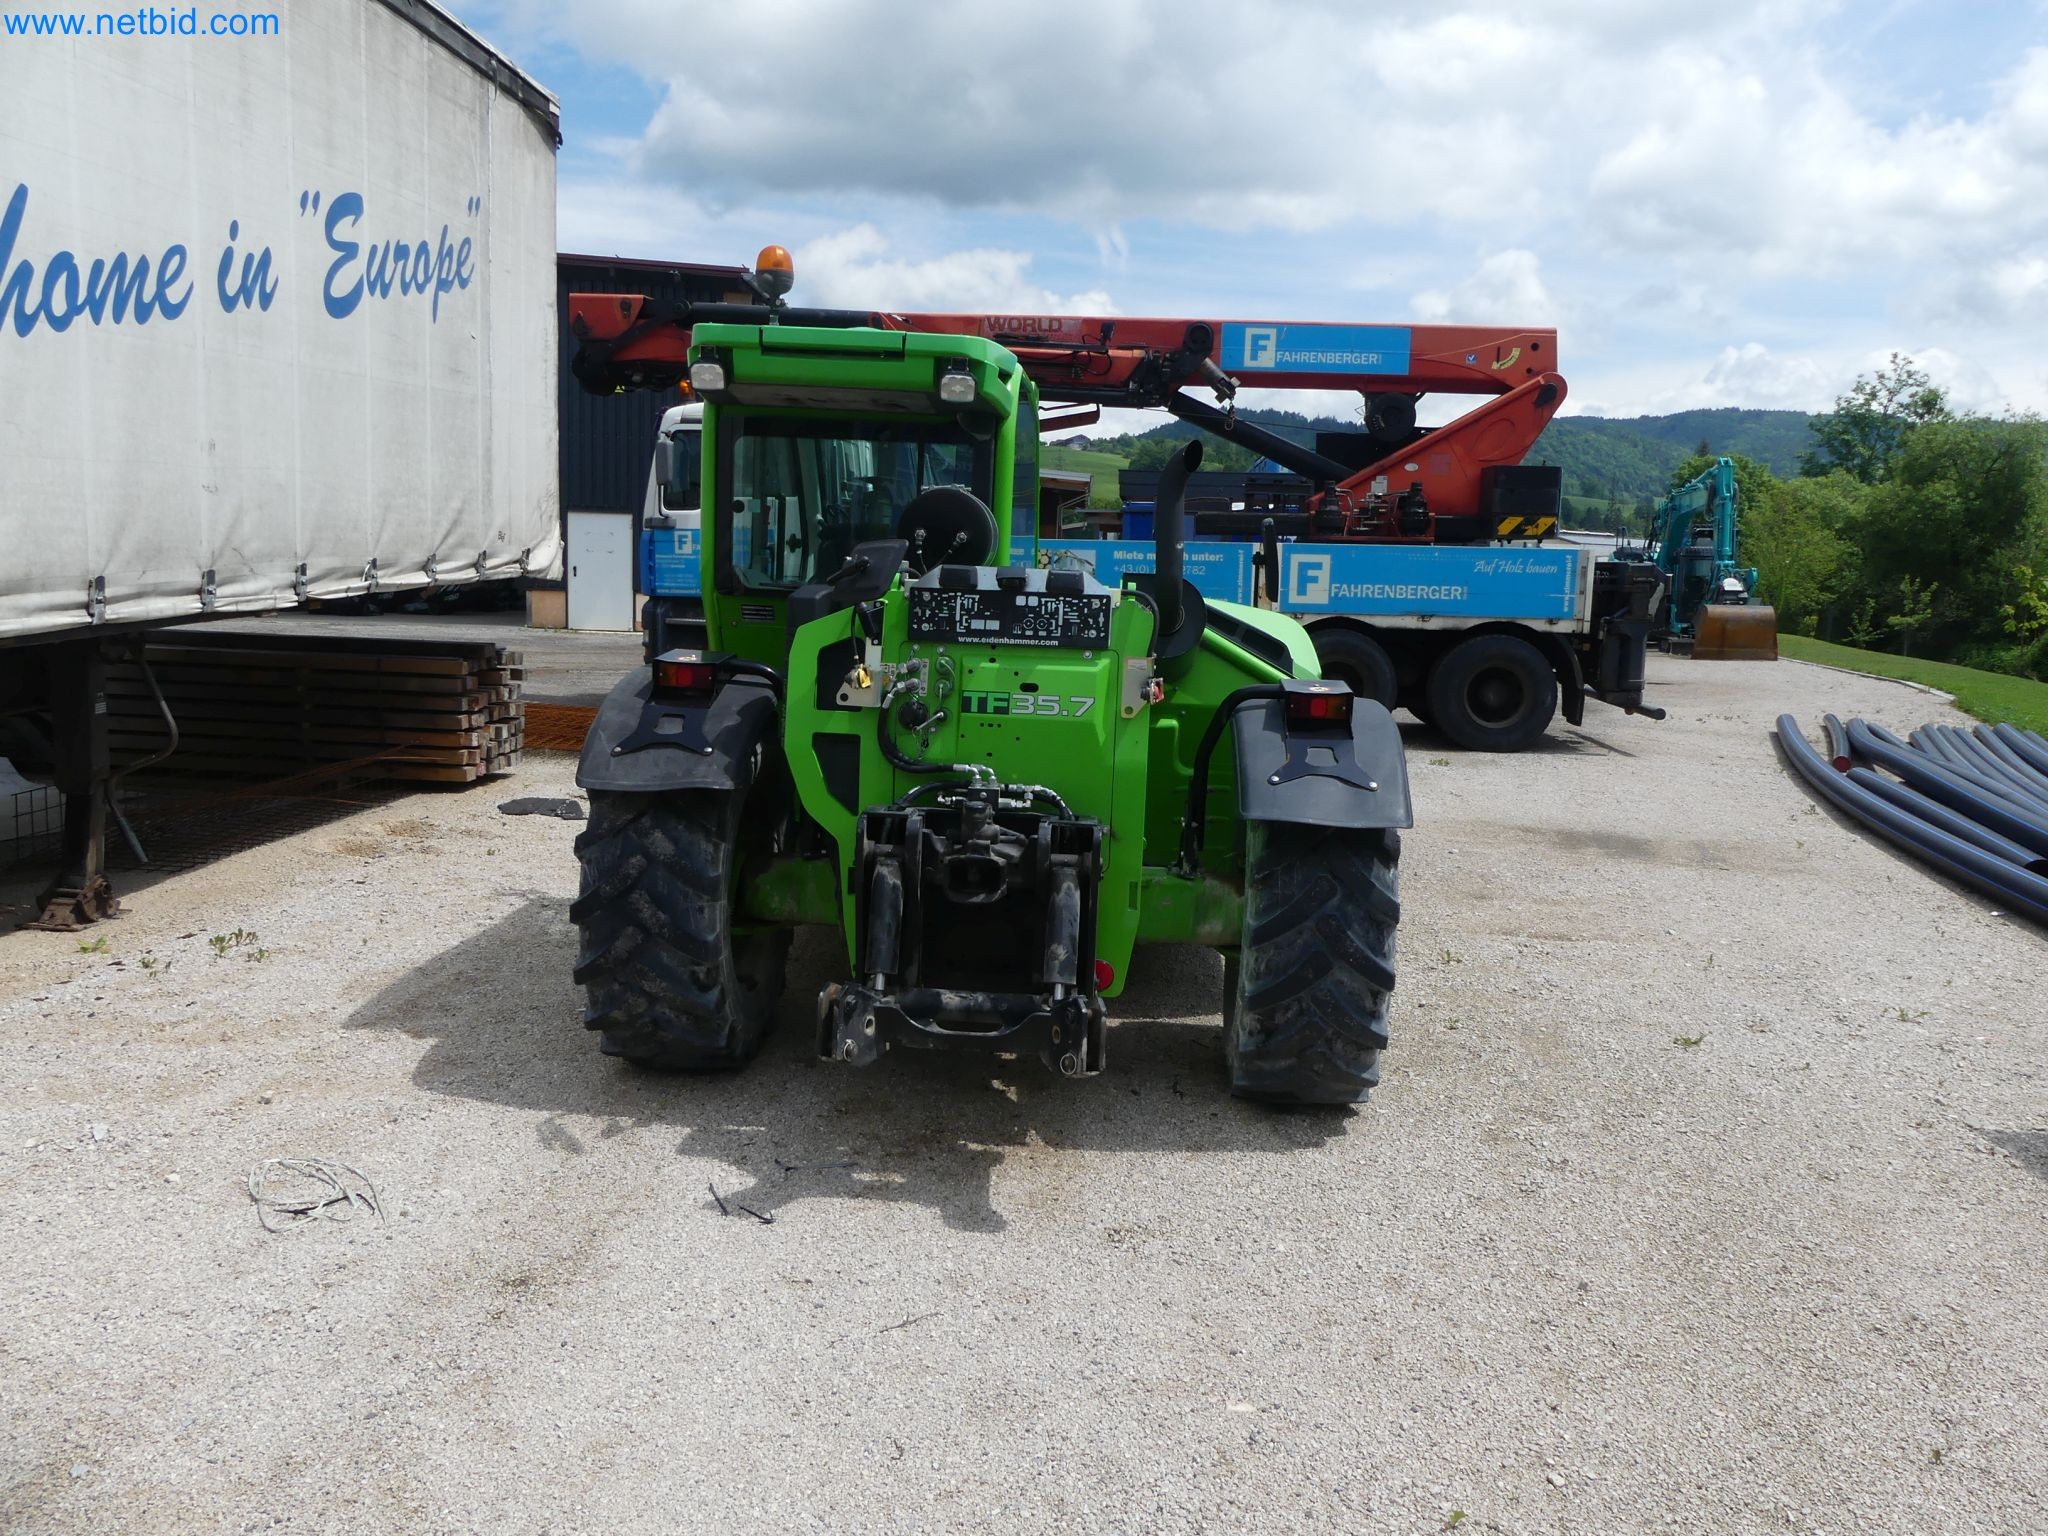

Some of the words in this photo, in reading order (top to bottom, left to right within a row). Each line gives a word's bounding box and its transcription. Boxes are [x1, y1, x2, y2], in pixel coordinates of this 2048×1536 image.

[0, 183, 194, 338] home
[217, 219, 279, 313] in
[985, 317, 1062, 333] WORLD
[1276, 351, 1377, 365] FAHRENBERGER
[1113, 550, 1144, 560] Miete
[1192, 552, 1224, 562] unter:
[1473, 559, 1499, 576] Auf
[1498, 558, 1525, 574] Holz
[1526, 559, 1558, 574] bauen
[1330, 583, 1462, 600] FAHRENBERGER
[957, 635, 1059, 647] www.eidenhammer.com
